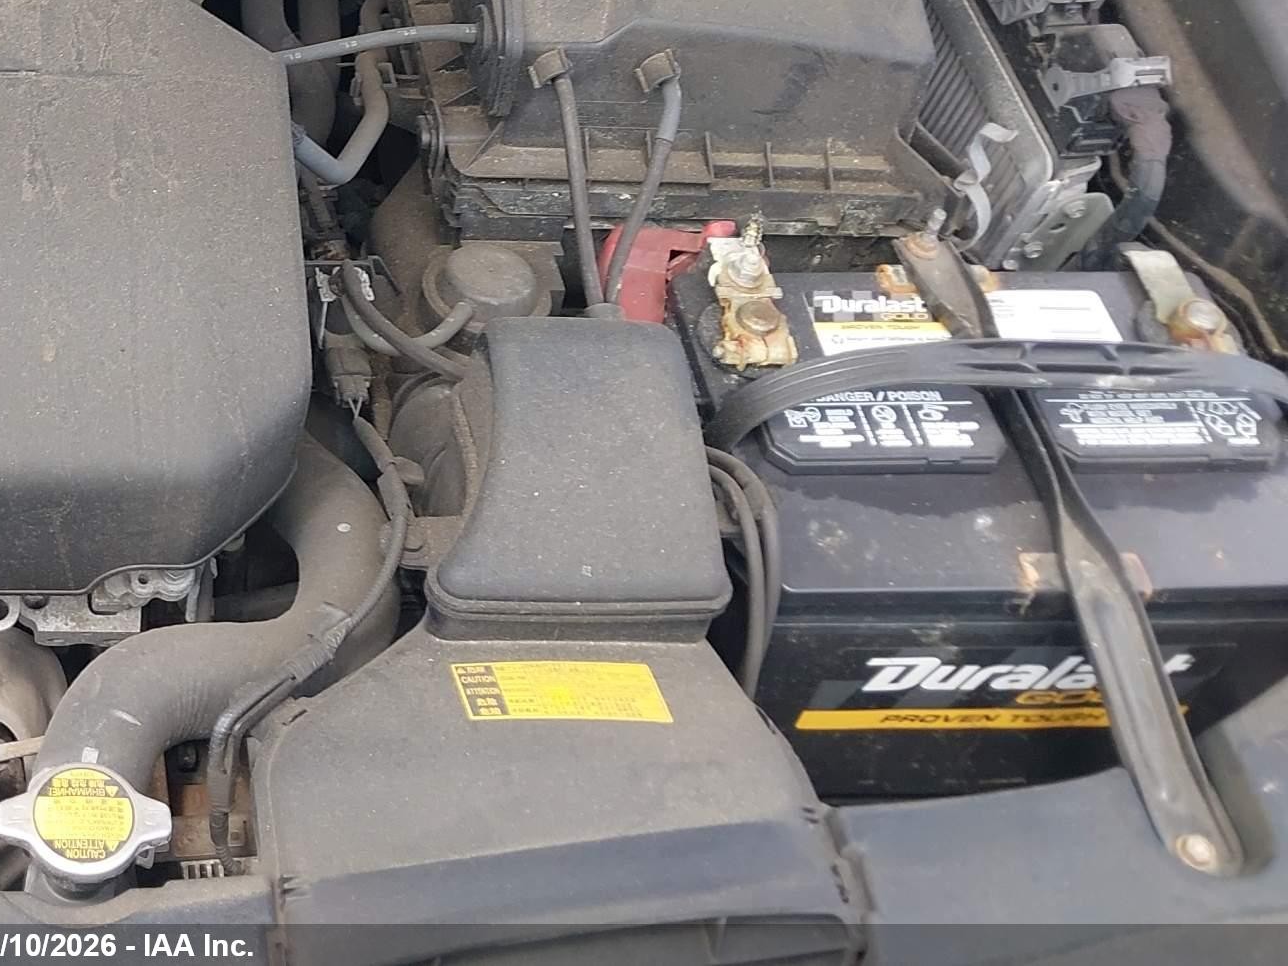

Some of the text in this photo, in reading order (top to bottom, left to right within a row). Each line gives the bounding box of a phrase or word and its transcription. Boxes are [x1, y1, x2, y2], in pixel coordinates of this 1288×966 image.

[813, 295, 928, 313] Duralast
[886, 391, 943, 401] POISON
[879, 714, 1000, 724] PROVEN
[54, 839, 105, 849] ATTENTION
[66, 849, 106, 859] CAUTION
